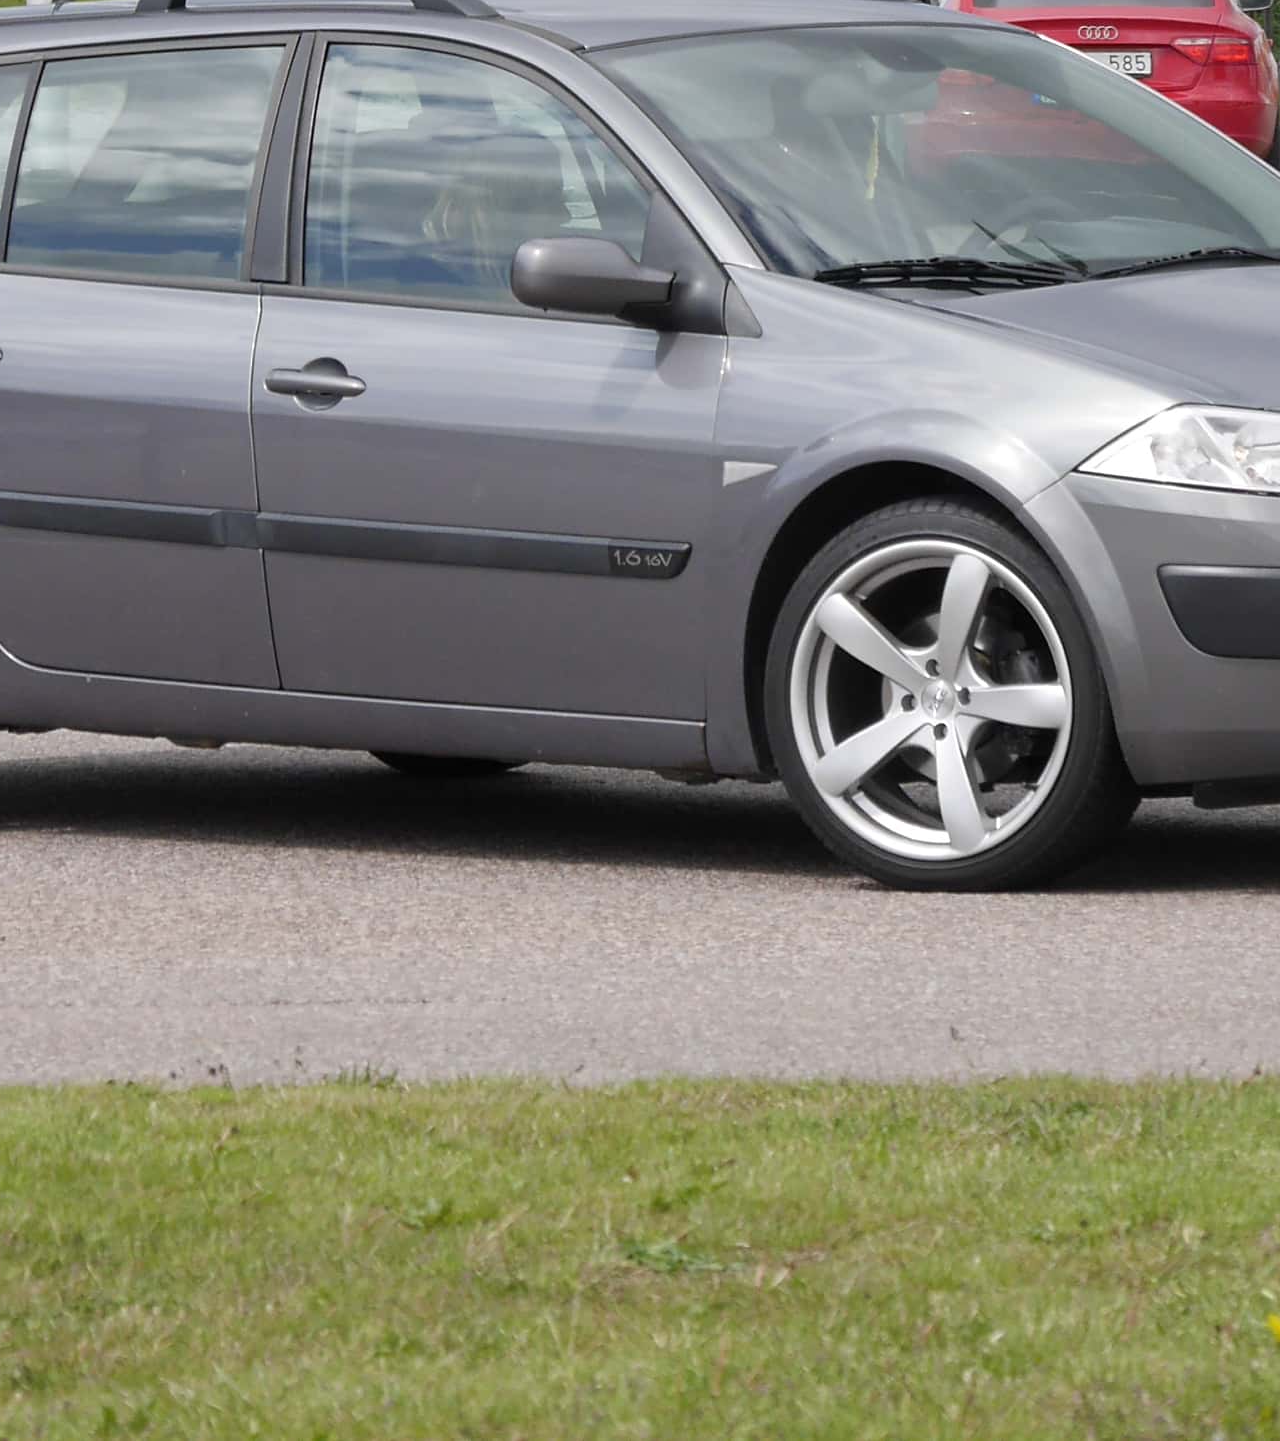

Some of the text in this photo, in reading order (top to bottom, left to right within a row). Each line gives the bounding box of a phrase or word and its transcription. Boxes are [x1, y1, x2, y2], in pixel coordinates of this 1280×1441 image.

[1109, 54, 1146, 71] 585
[613, 549, 672, 567] 1.6 16V
